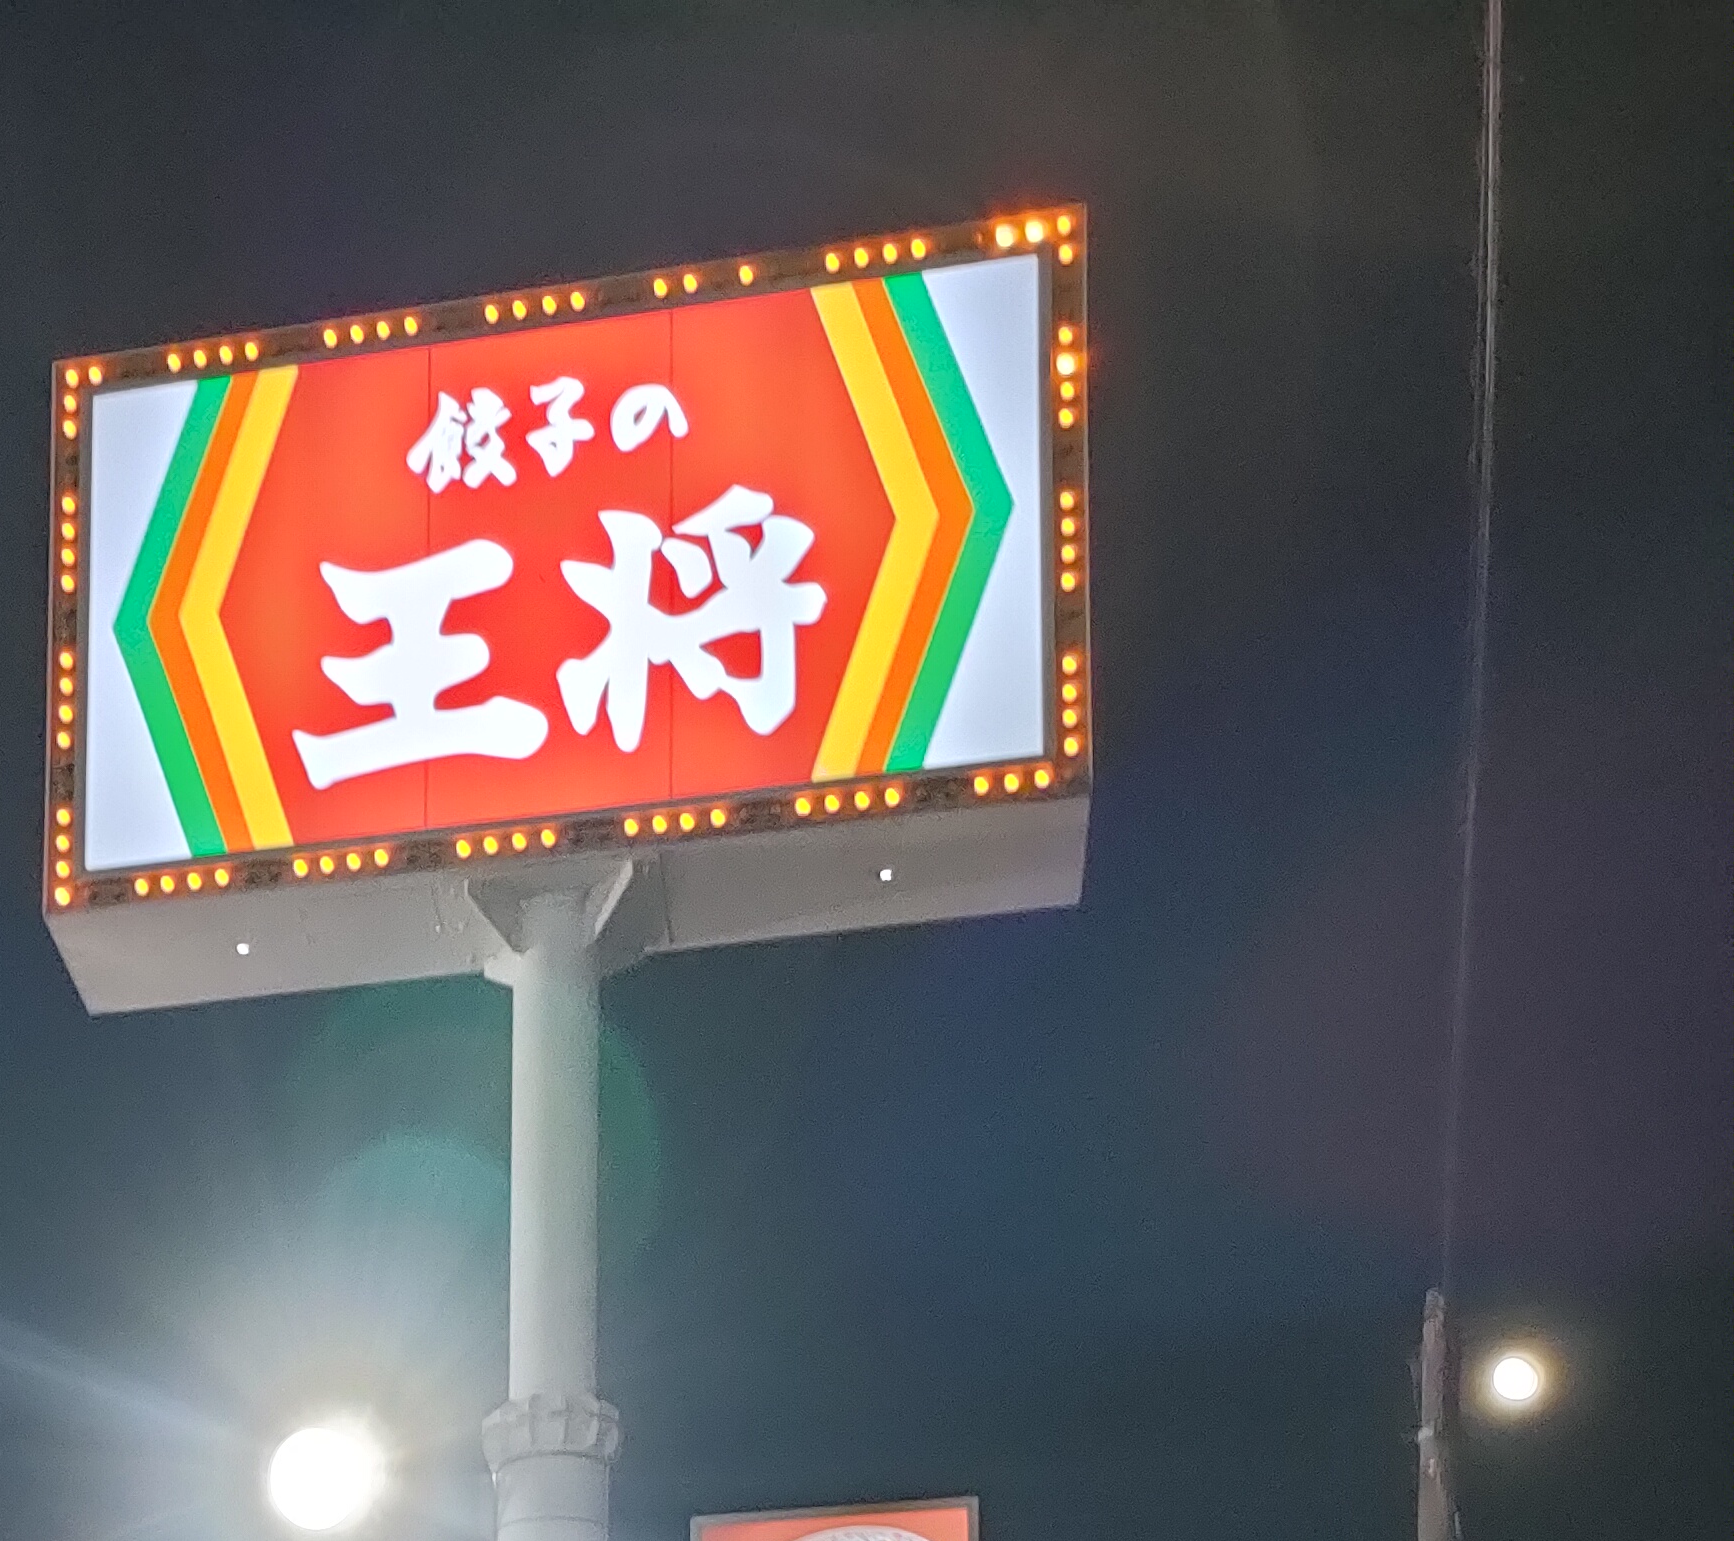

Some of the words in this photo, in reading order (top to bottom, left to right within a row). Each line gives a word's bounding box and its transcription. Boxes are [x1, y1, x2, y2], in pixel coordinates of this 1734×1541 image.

[407, 376, 688, 492] 餃子の
[293, 484, 827, 790] 王将
